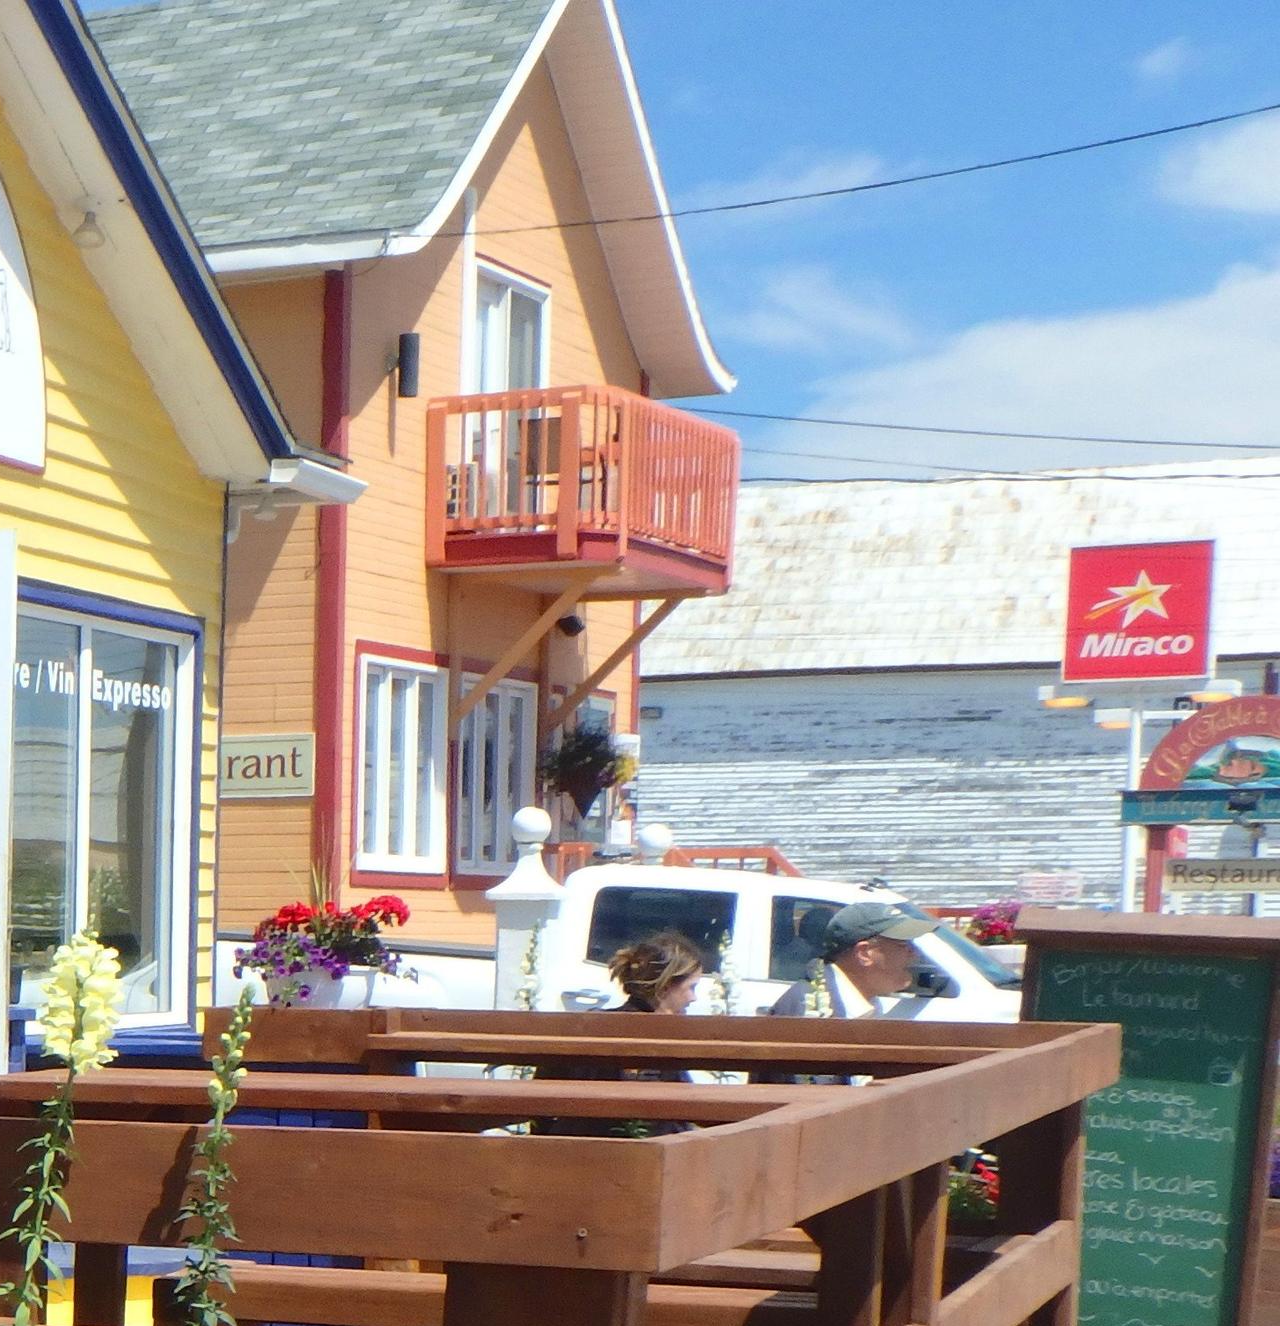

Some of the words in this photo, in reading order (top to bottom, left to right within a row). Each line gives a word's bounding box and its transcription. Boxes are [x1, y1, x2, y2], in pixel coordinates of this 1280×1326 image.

[1079, 631, 1195, 659] Miraco
[47, 660, 74, 695] Vin
[92, 668, 171, 711] Expresso
[1171, 864, 1280, 886] Restaur
[1132, 1166, 1218, 1198] locales
